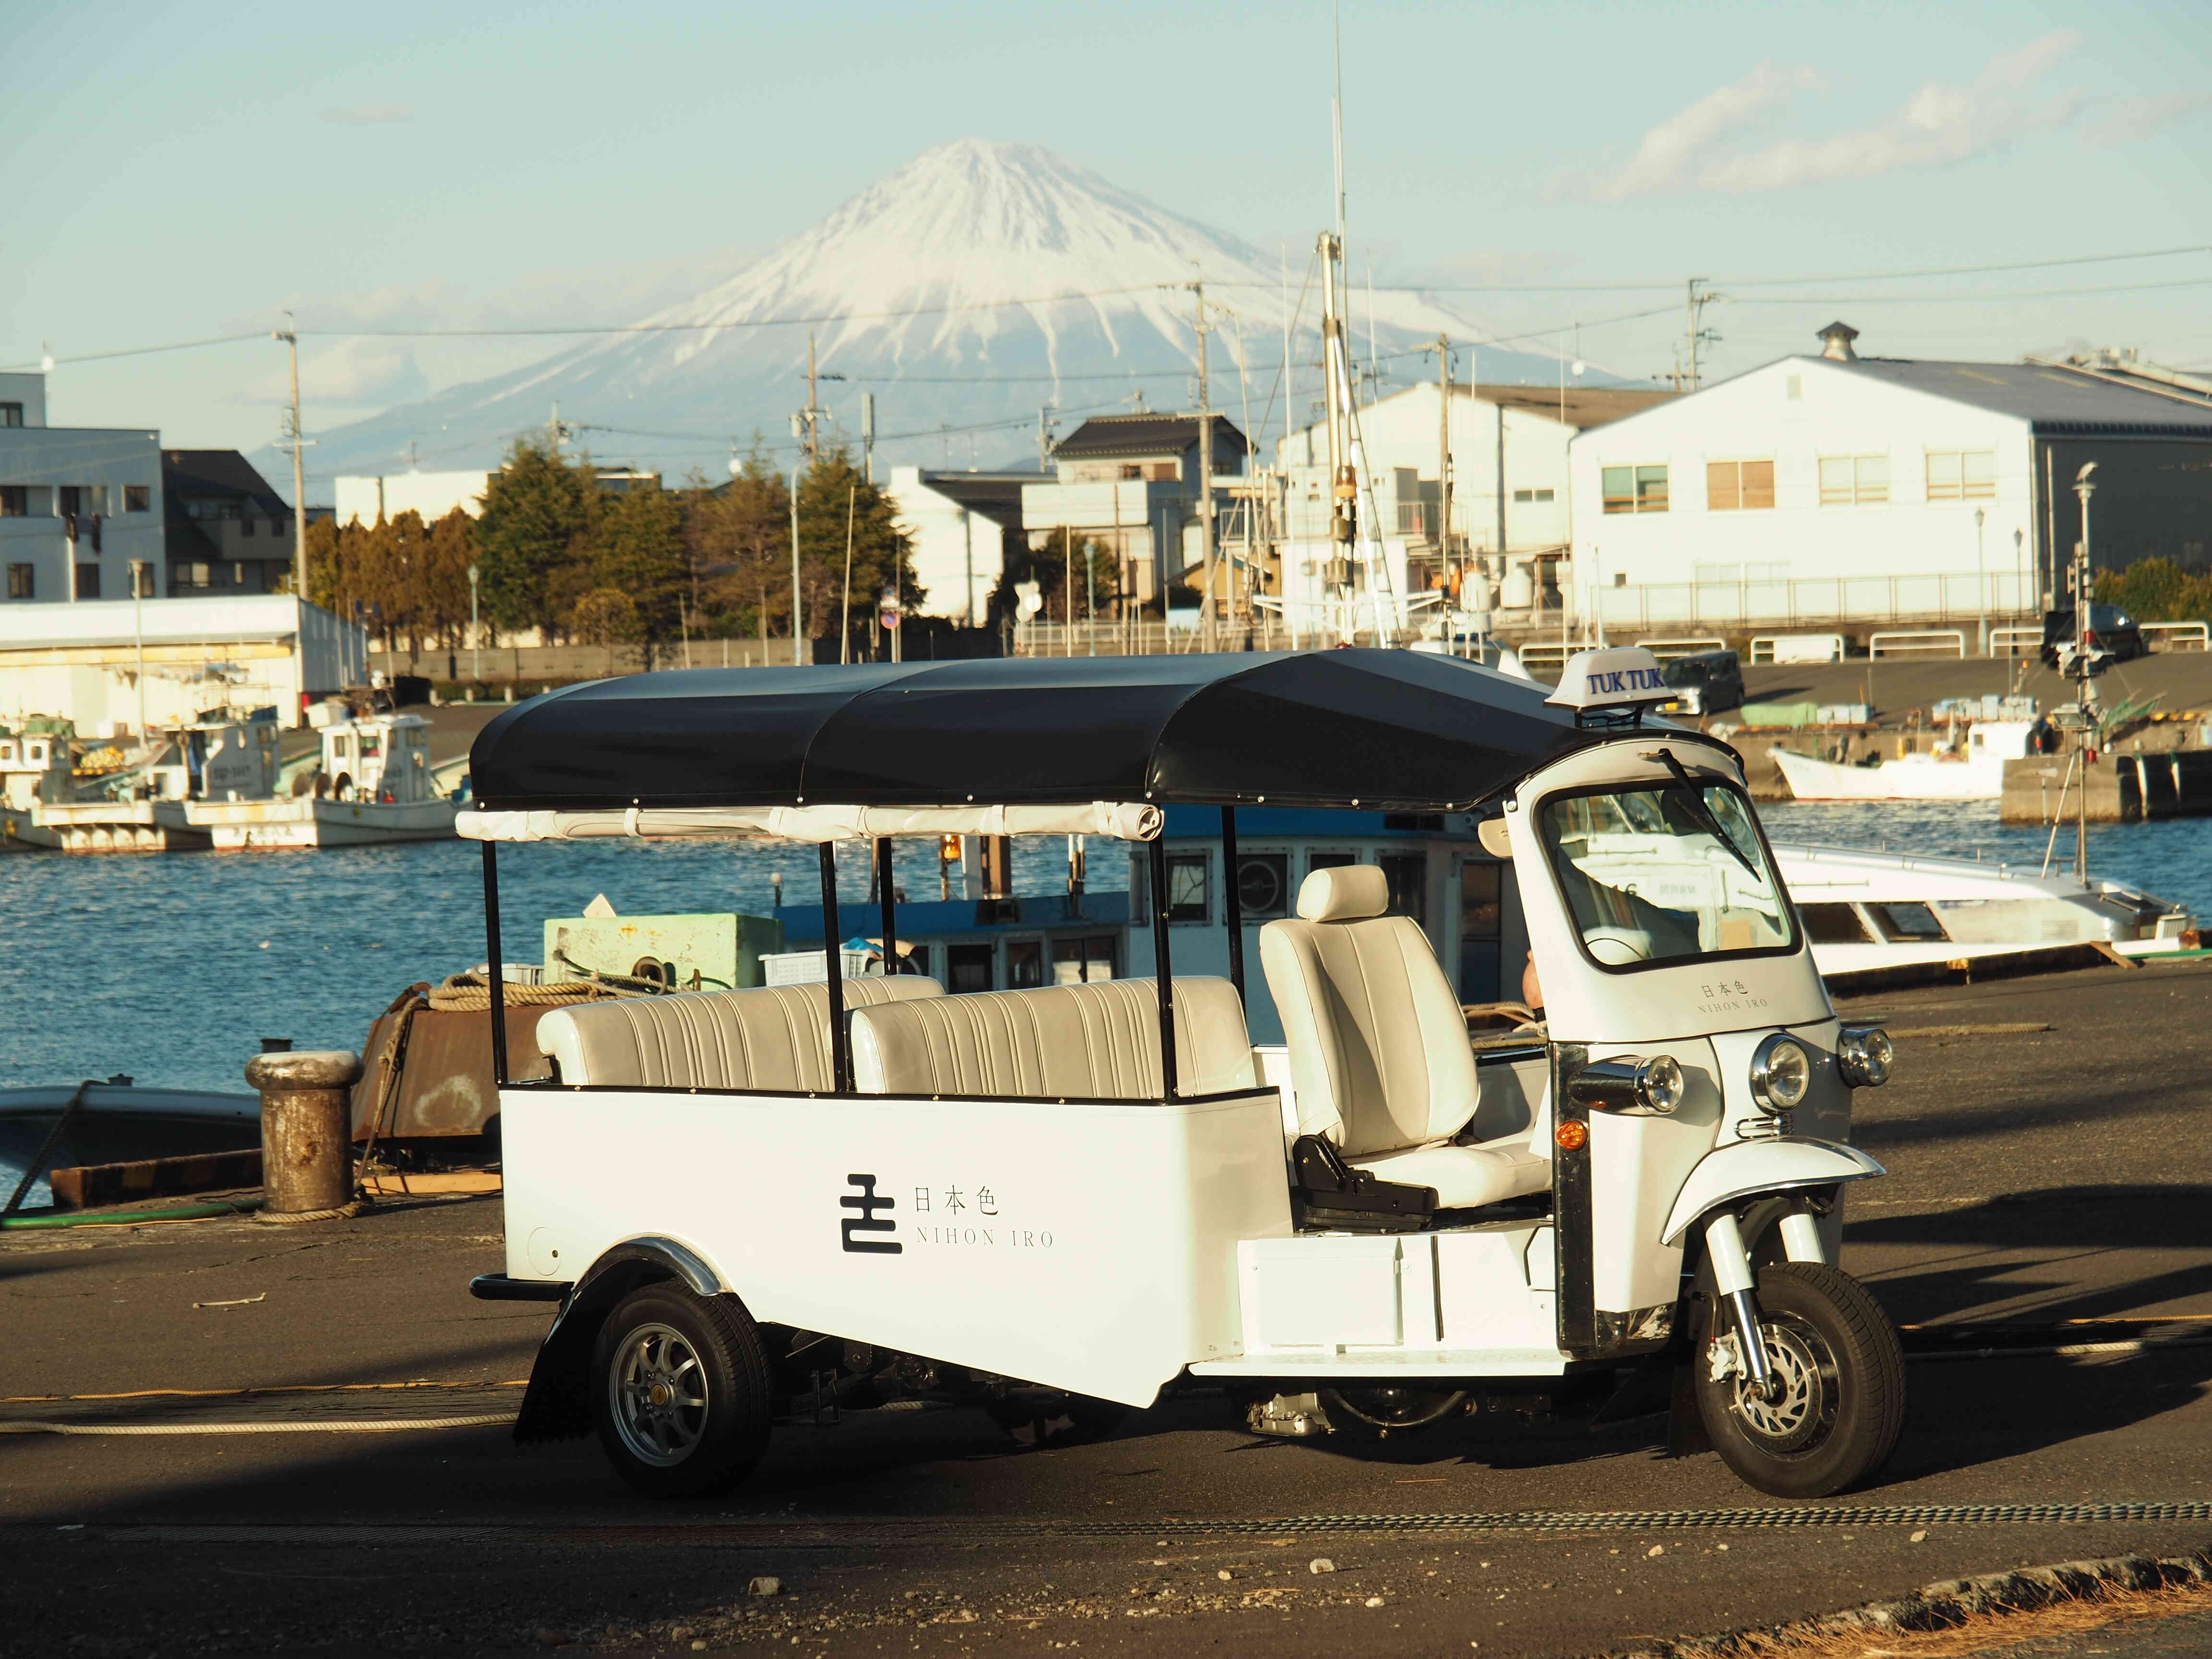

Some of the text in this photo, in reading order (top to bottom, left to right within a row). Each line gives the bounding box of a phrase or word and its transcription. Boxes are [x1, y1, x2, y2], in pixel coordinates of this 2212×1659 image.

[1587, 668, 1665, 694] TUK TUK
[1701, 980, 1748, 998] 日本色
[1698, 998, 1767, 1014] NIHON IRO
[915, 1184, 998, 1215] 日本色
[916, 1226, 1053, 1248] NIHON IRO
